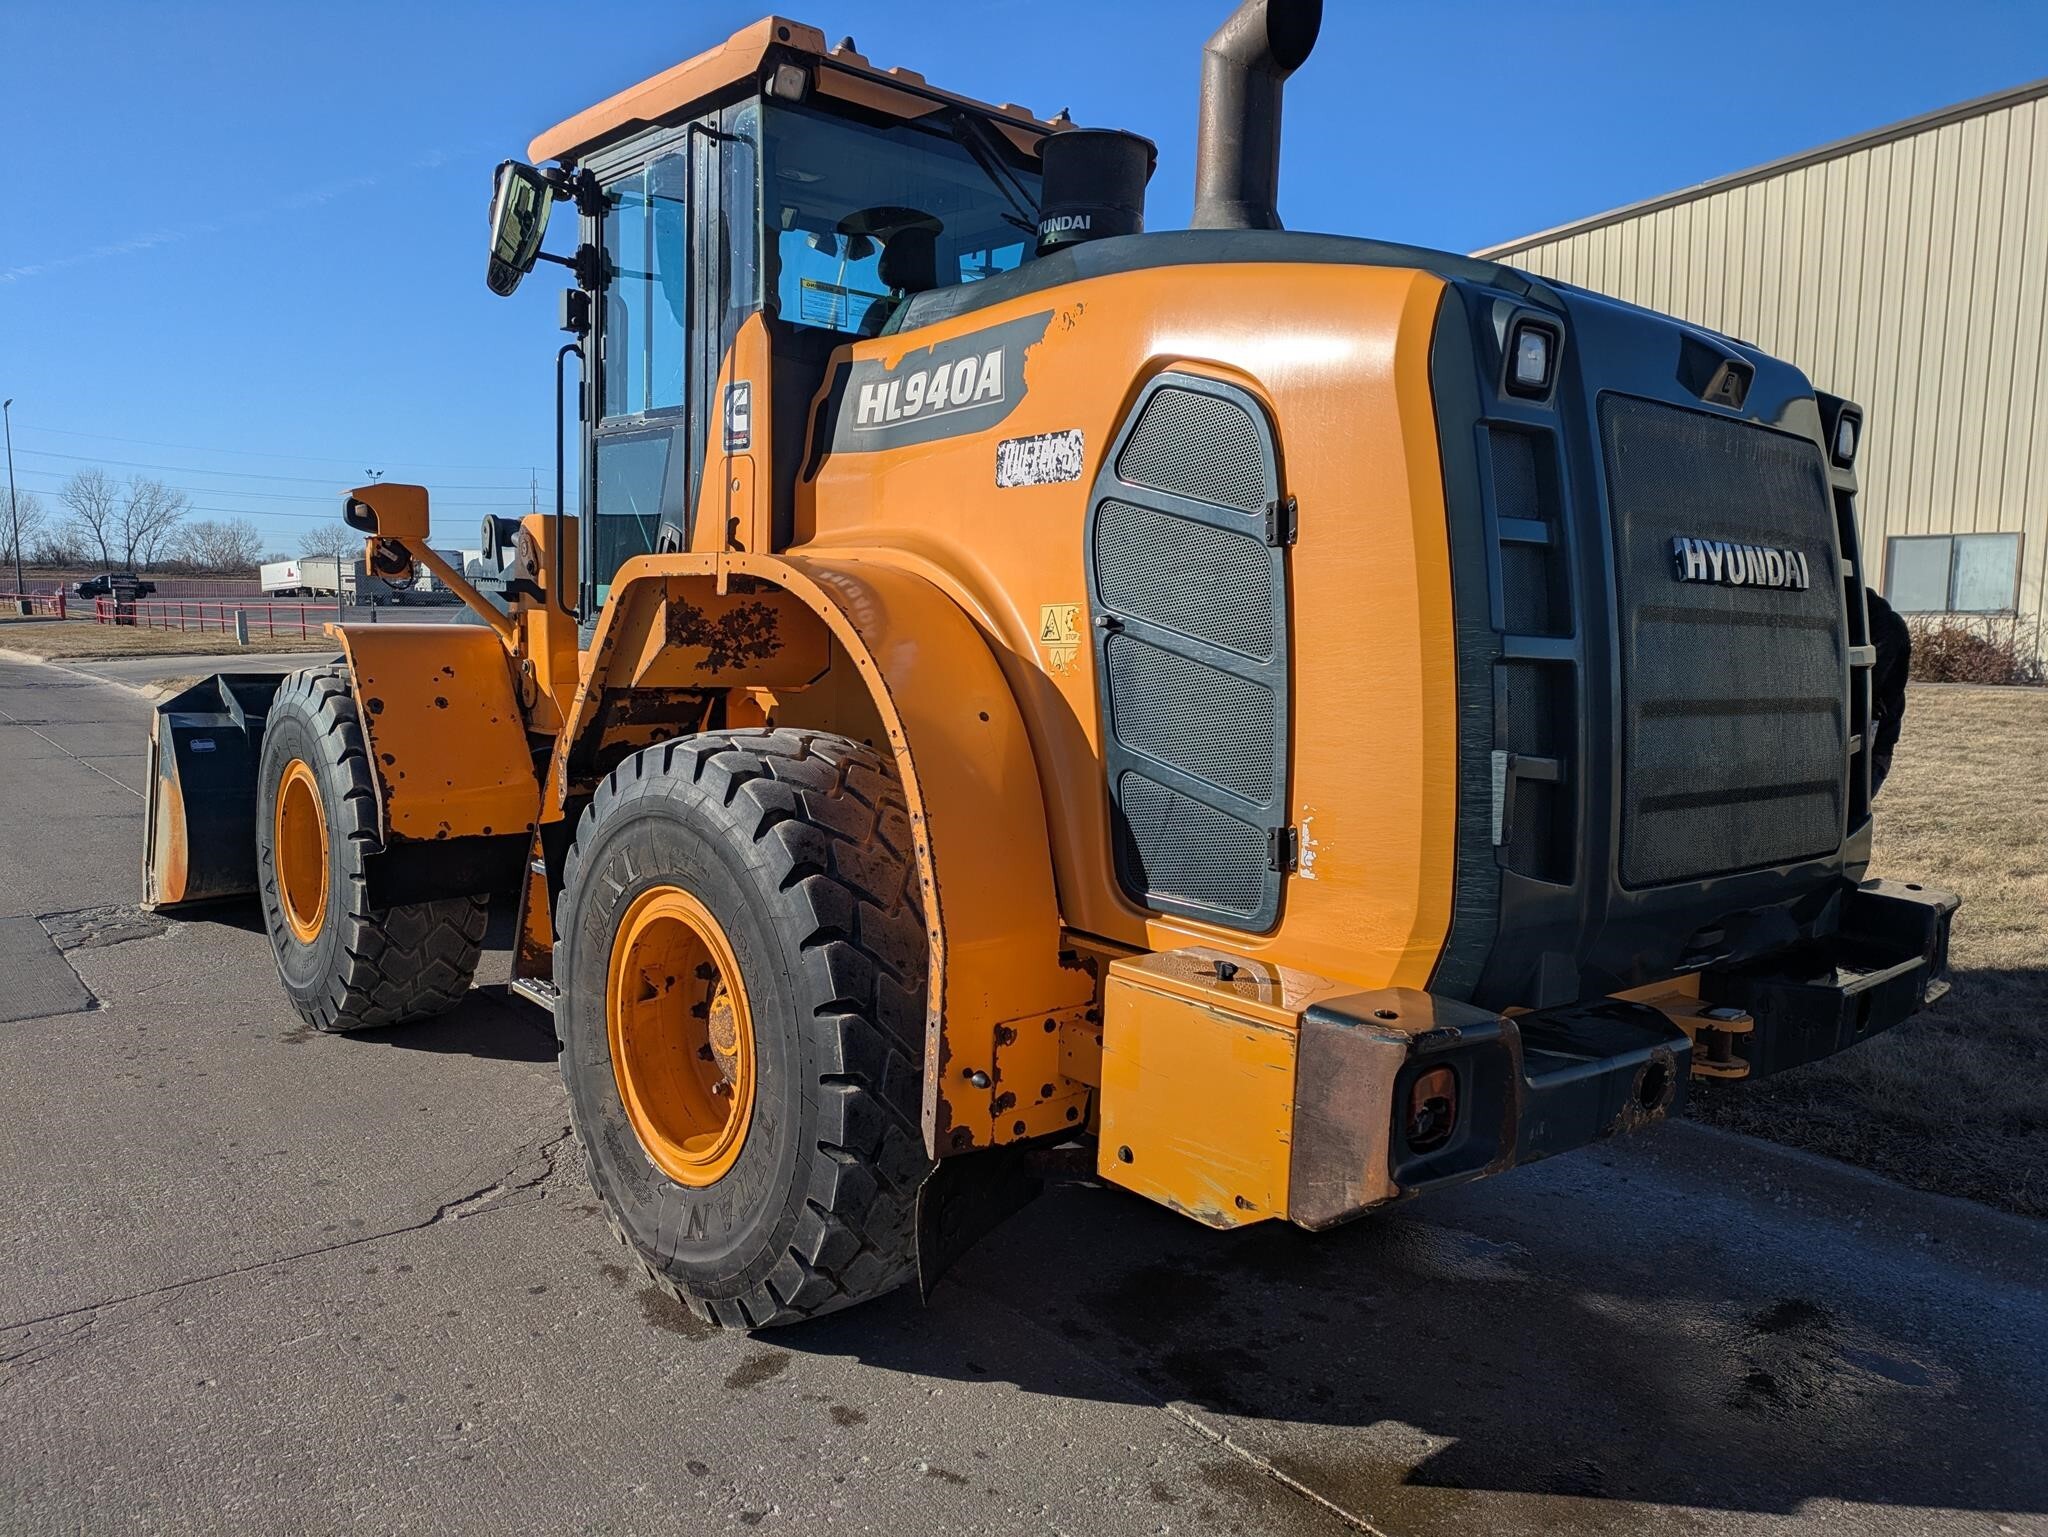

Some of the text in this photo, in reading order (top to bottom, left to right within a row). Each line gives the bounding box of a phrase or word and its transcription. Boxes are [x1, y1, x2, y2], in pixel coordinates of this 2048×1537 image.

[1038, 215, 1091, 237] YUNDAI
[856, 350, 1003, 425] HL940A
[1683, 537, 1810, 589] HYUNDAI
[685, 1112, 778, 1241] TITAN
